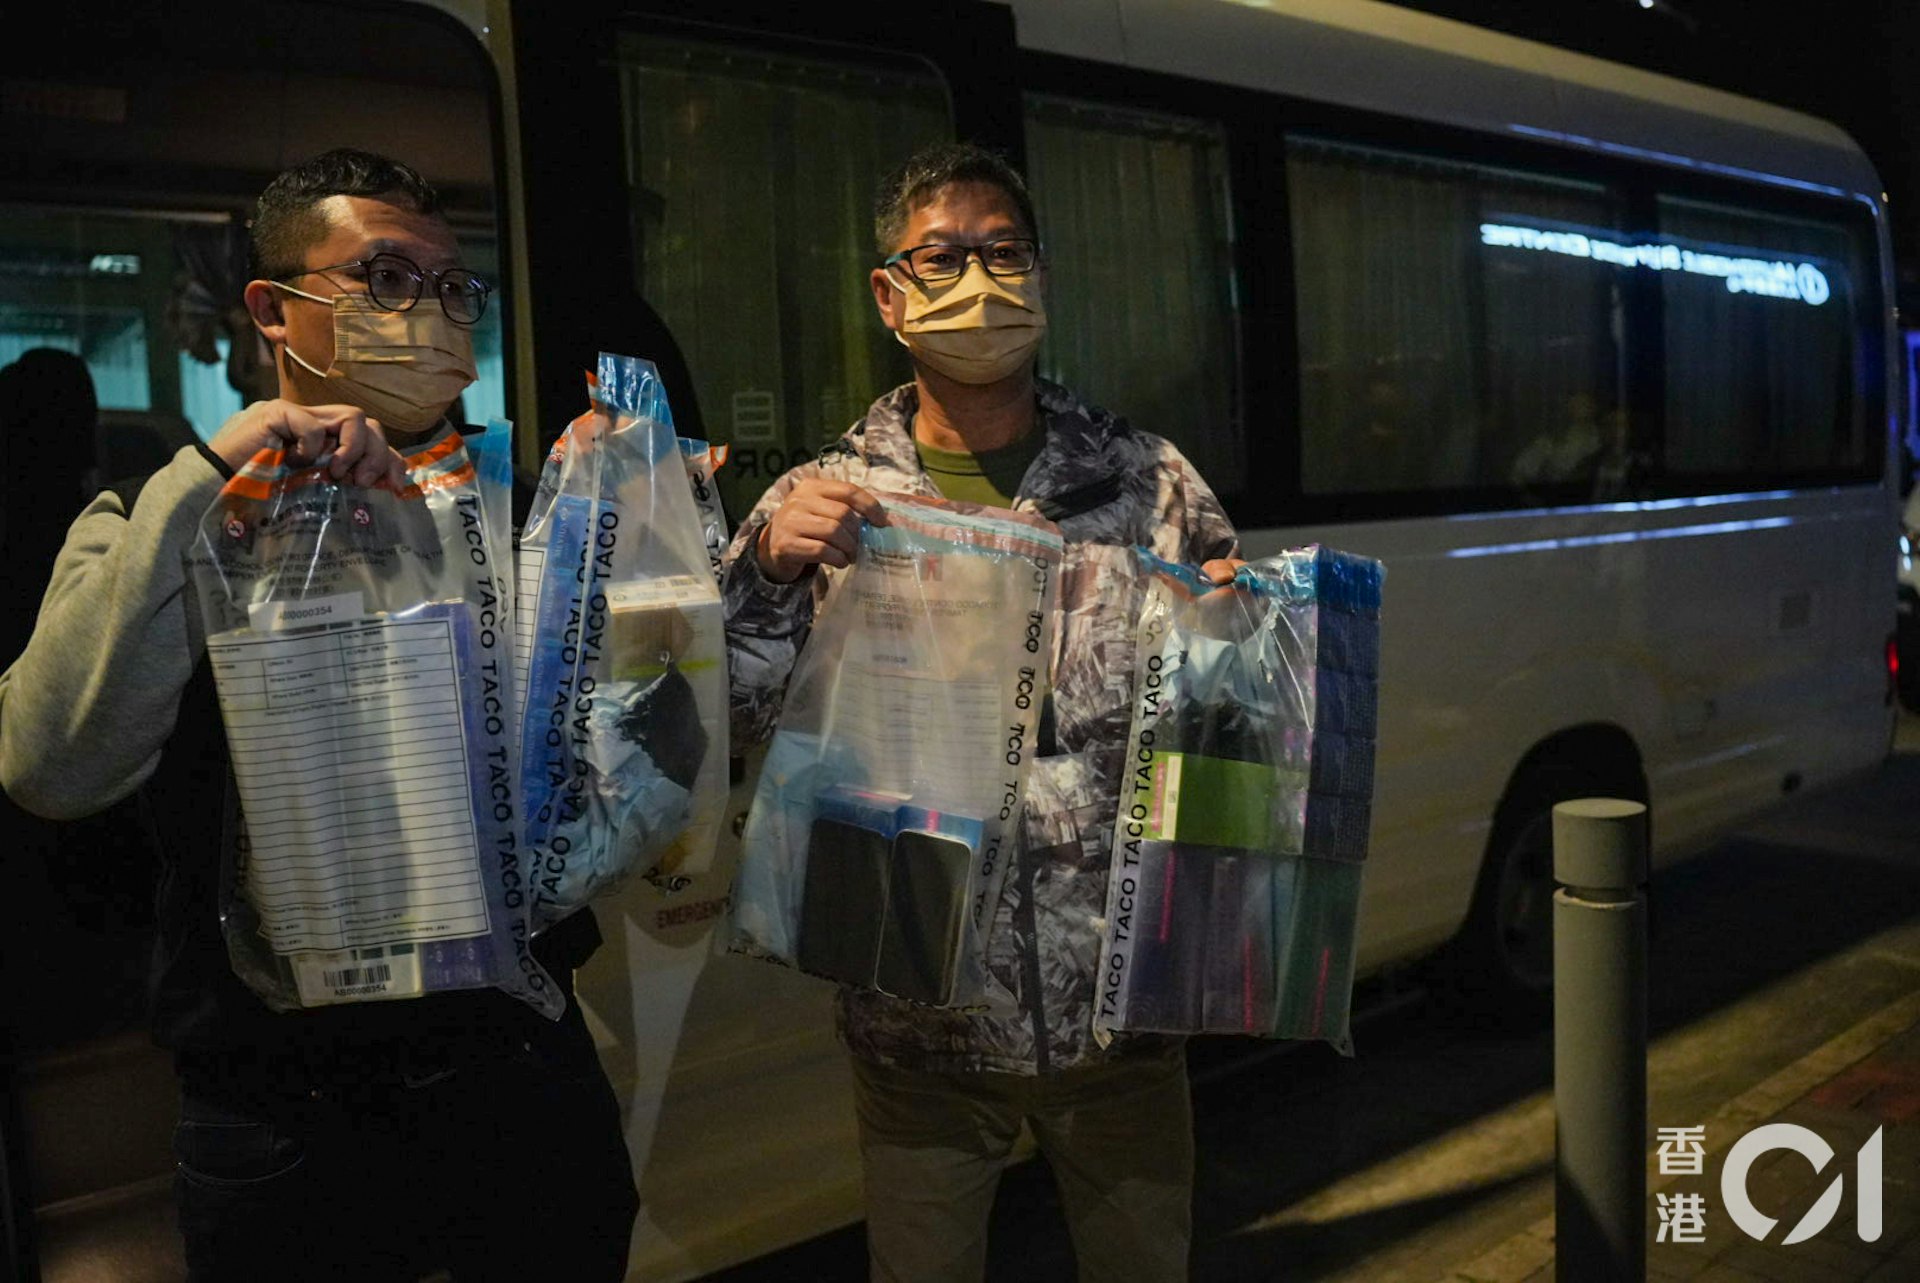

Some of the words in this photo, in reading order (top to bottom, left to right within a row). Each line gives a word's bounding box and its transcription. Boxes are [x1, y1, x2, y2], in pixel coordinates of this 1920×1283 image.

[456, 494, 487, 567] TACO
[593, 512, 618, 583] TACO
[477, 576, 498, 649] TACO
[583, 594, 607, 665] TACO
[1024, 610, 1043, 654] TCO
[482, 660, 502, 735] TACO
[547, 676, 574, 747] TACO
[571, 677, 596, 745] TACO
[1015, 667, 1036, 710] TCO
[1143, 655, 1163, 719] TACO
[1006, 722, 1026, 766] TCO
[1134, 729, 1156, 793] TACO
[488, 745, 513, 823] TACO
[539, 757, 565, 823] TAO
[559, 757, 589, 825] TACO
[1000, 780, 1018, 821] TCO
[982, 835, 1001, 877] TCO
[1123, 803, 1148, 868] TACO
[498, 832, 523, 909] TACO
[536, 836, 571, 908] TACO
[1115, 878, 1136, 943] TACO
[511, 918, 545, 992] TACO
[1101, 953, 1124, 1018] TACO
